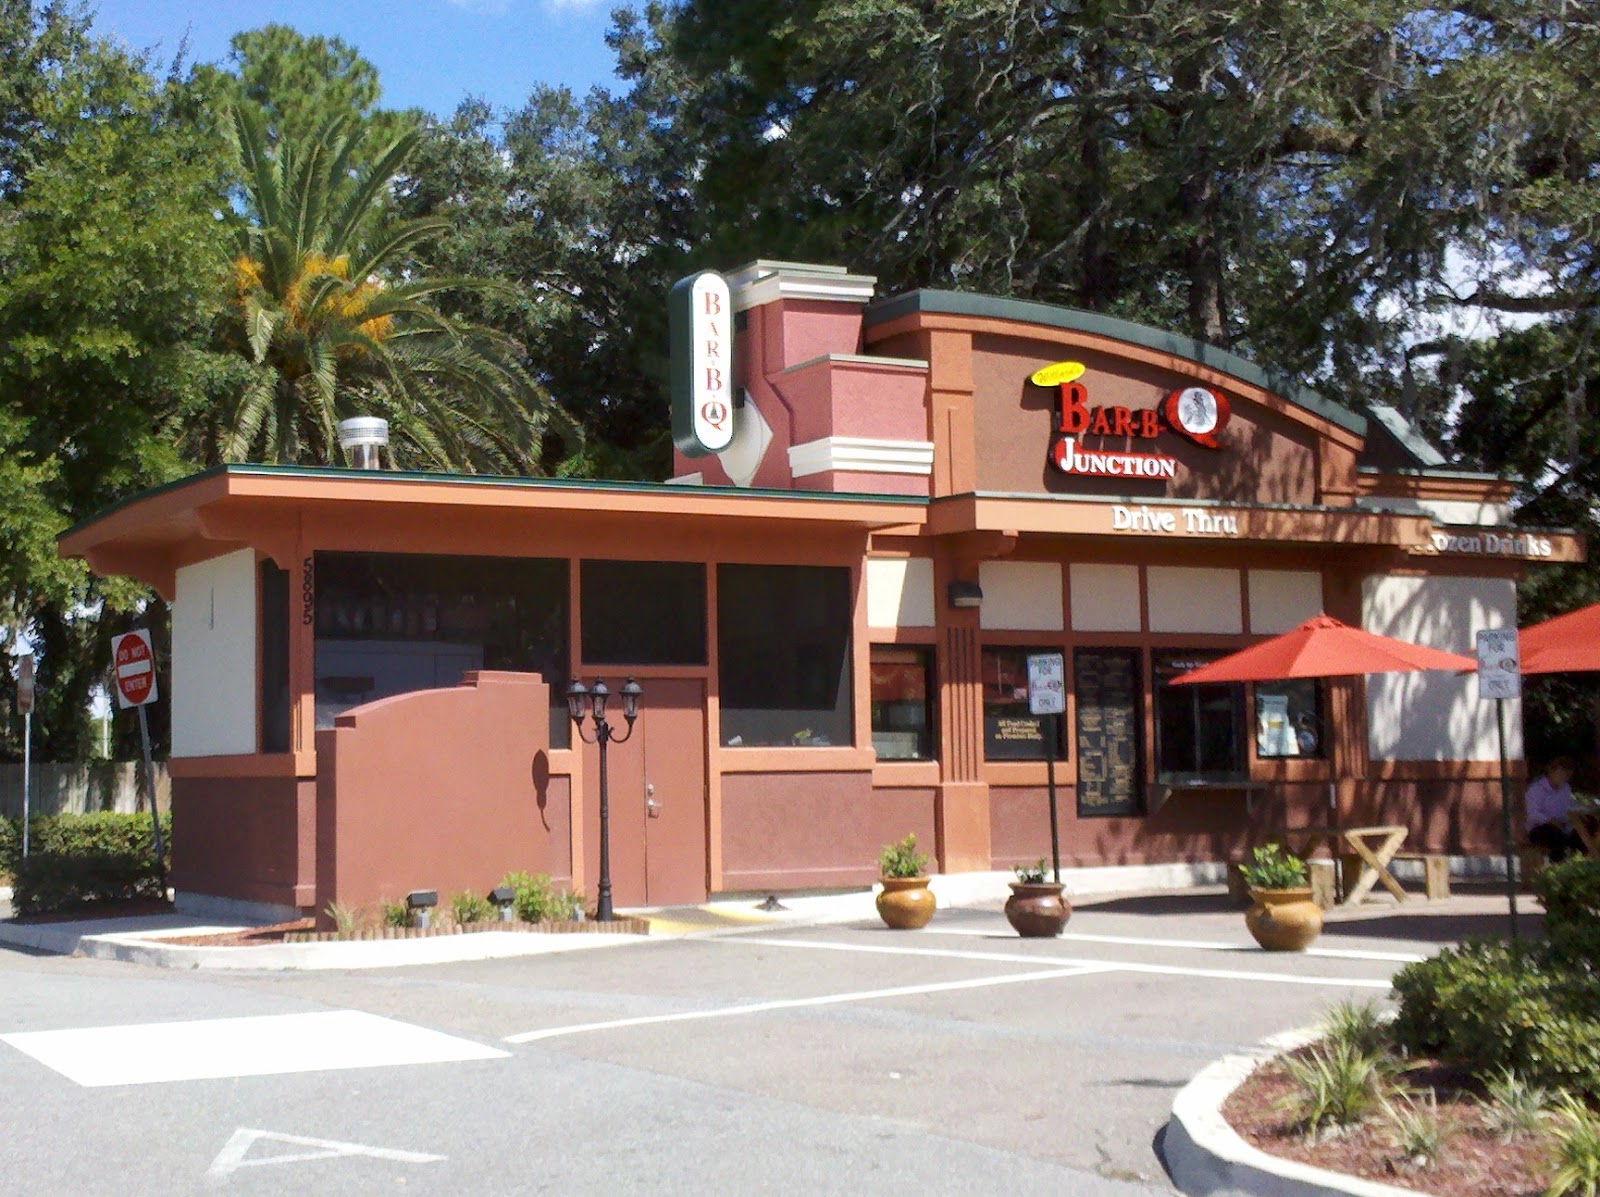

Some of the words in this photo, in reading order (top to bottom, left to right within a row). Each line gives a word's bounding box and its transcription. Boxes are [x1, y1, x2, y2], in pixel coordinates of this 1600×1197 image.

[1060, 437, 1176, 478] JUNCTION
[1112, 505, 1176, 532] Drive
[1182, 508, 1238, 535] Thru
[1485, 533, 1552, 556] Drinks
[119, 648, 129, 661] DO
[131, 644, 146, 658] NOT
